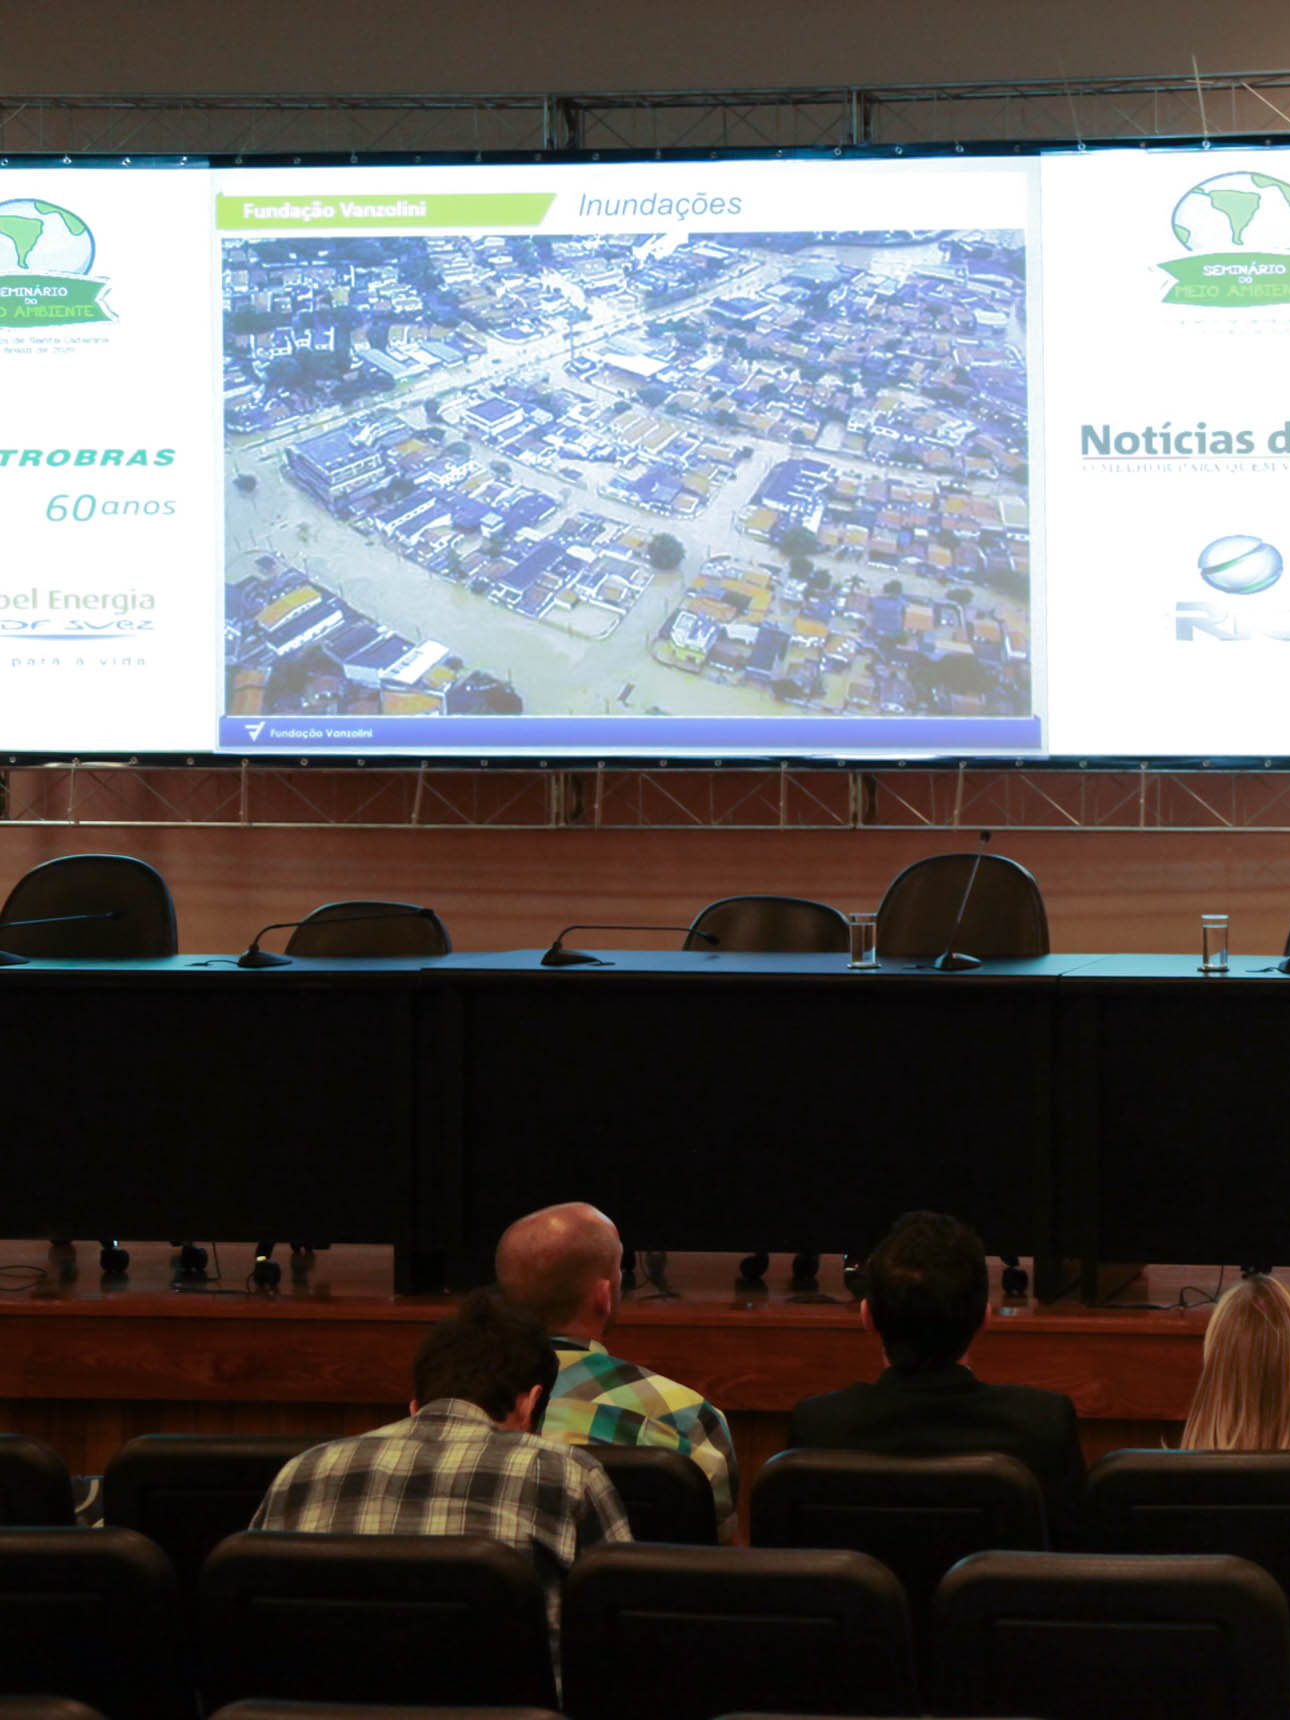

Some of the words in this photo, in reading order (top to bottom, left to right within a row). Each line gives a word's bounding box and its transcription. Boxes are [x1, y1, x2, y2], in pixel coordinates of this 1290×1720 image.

[243, 201, 336, 222] Fundação
[339, 199, 427, 217] Vanzolini
[578, 192, 743, 221] Inundações
[1203, 261, 1287, 276] SEMINÁRIO
[1175, 285, 1219, 298] MEIO
[13, 304, 96, 319] AMBIENTE
[1080, 421, 1256, 456] Notícias
[46, 494, 97, 522] 60
[101, 500, 176, 515] anos
[48, 588, 155, 615] Energia
[270, 728, 323, 739] Fundação
[325, 728, 373, 738] Vanzolini
